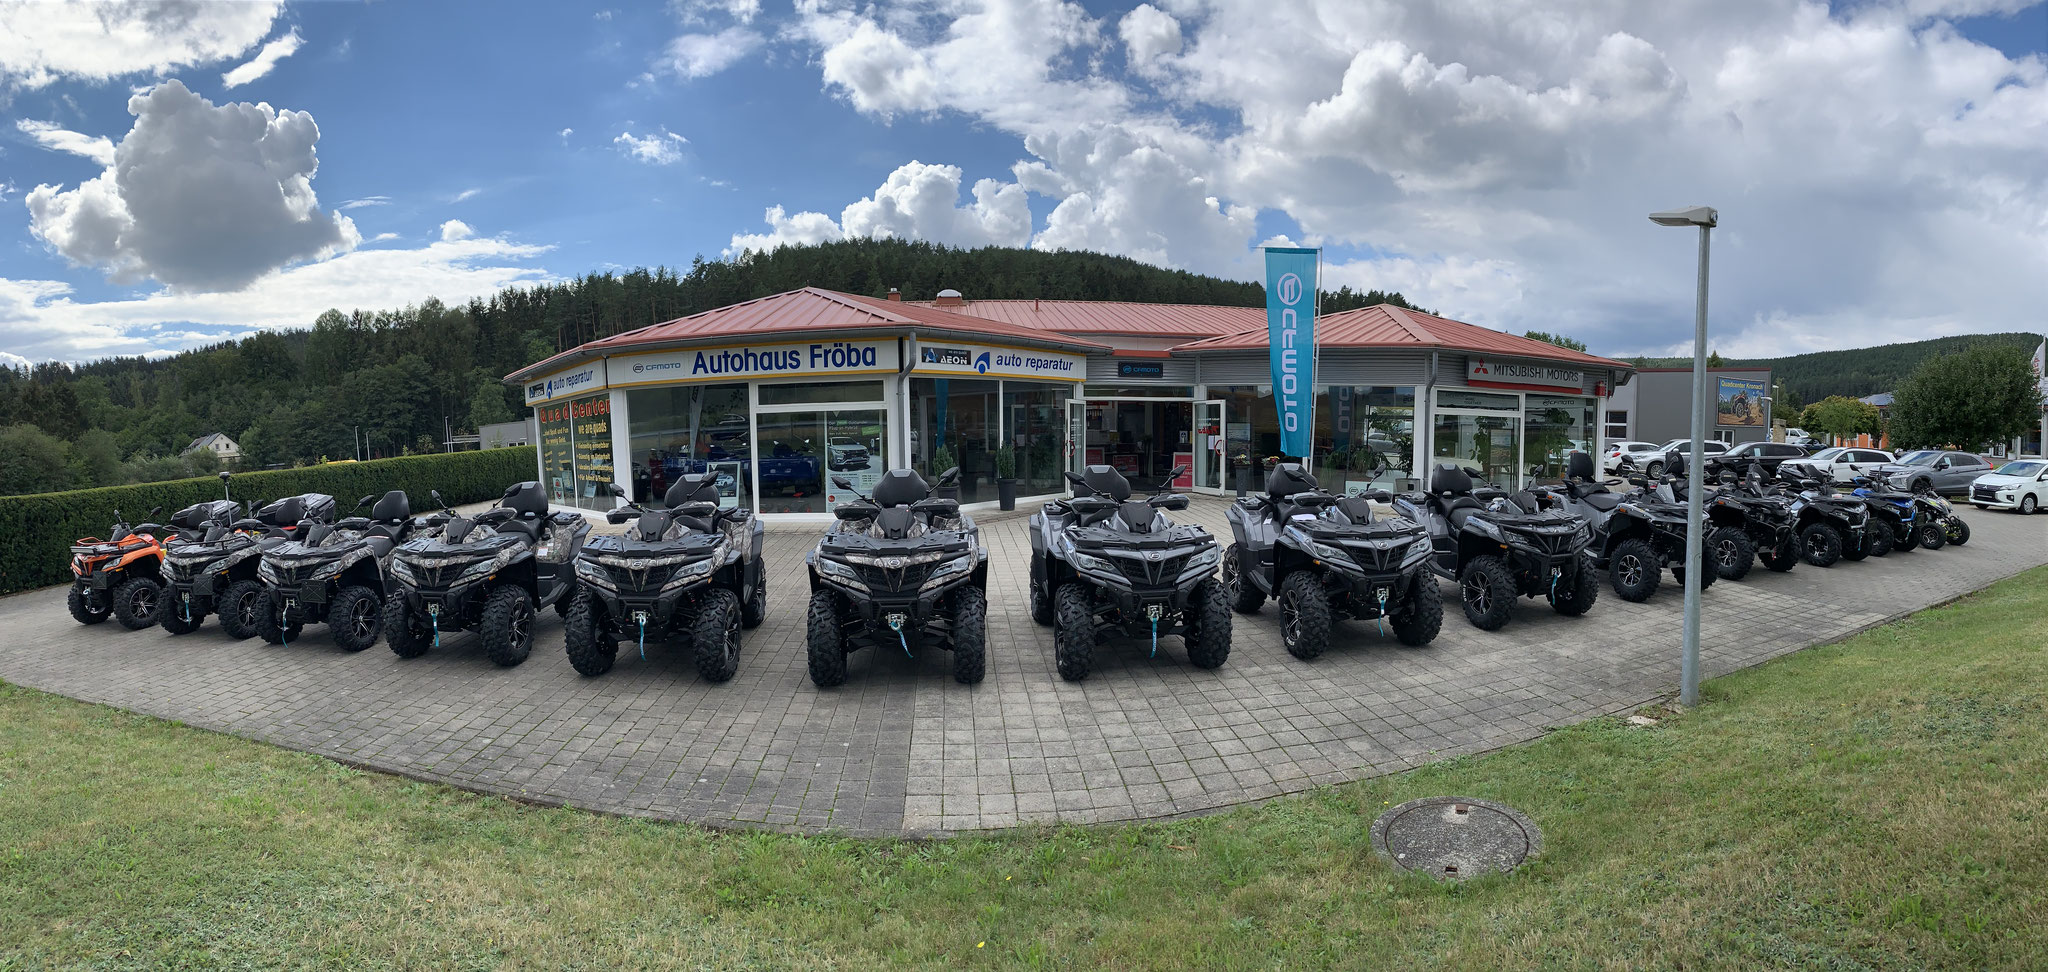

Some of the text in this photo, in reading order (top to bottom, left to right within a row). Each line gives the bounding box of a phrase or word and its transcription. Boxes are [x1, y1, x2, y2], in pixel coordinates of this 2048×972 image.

[646, 362, 681, 371] CFMOTO
[692, 342, 876, 375] Autohaus Fröba
[940, 355, 968, 365] AEON
[996, 353, 1073, 371] auto reparatur
[554, 370, 593, 390] auto reparatur
[1493, 364, 1579, 382] MITSUBISHI MOTORS
[540, 399, 610, 424] Quad Center
[593, 419, 607, 436] quads
